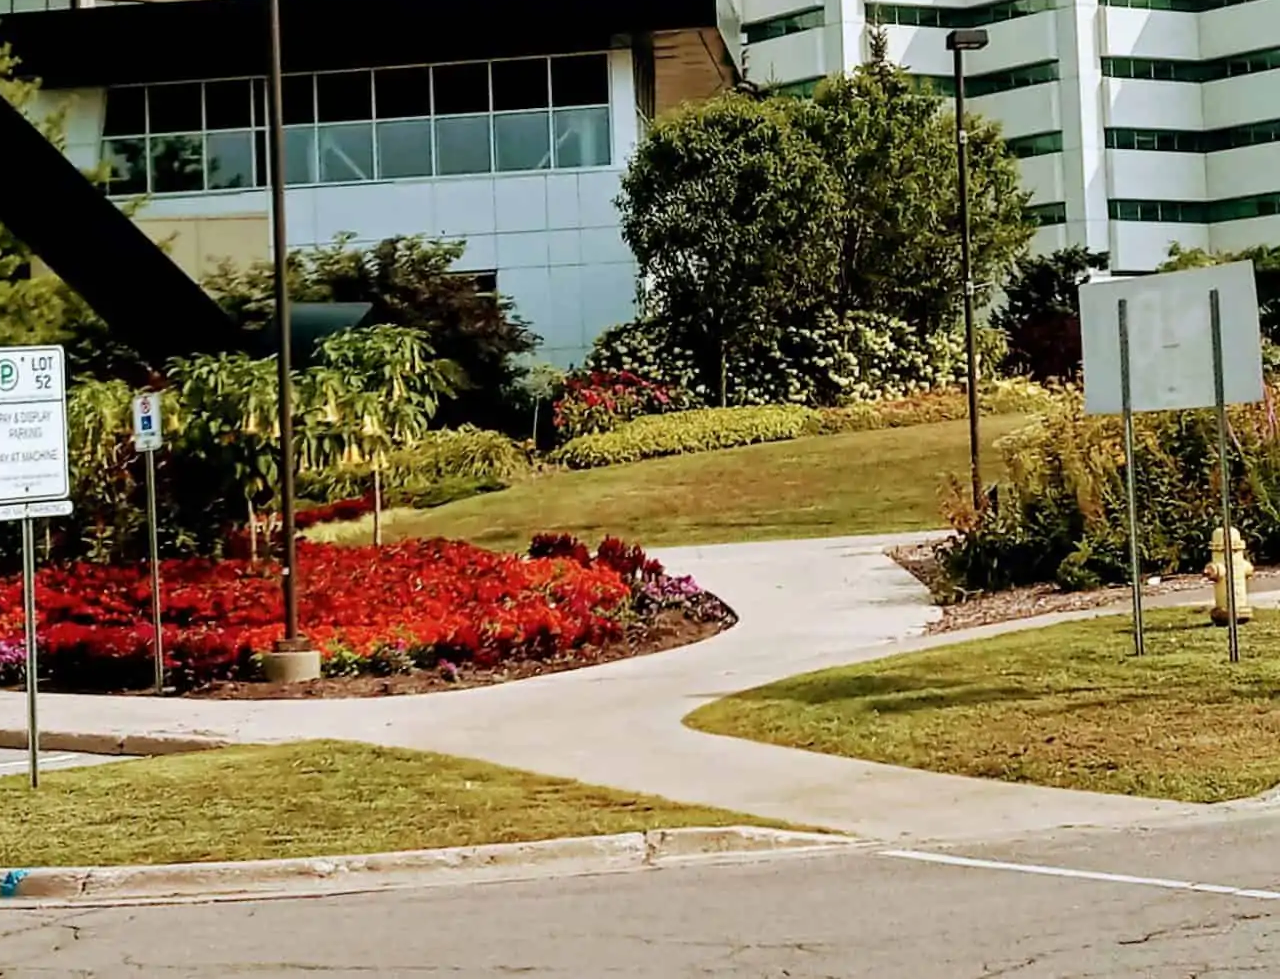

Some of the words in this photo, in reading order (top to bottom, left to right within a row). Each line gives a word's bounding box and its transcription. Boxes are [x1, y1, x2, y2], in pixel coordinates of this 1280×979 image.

[31, 356, 54, 371] LOT
[35, 374, 52, 389] 52
[20, 410, 52, 423] DISPLAY
[8, 426, 43, 438] PARKING
[21, 448, 58, 461] MACHINE
